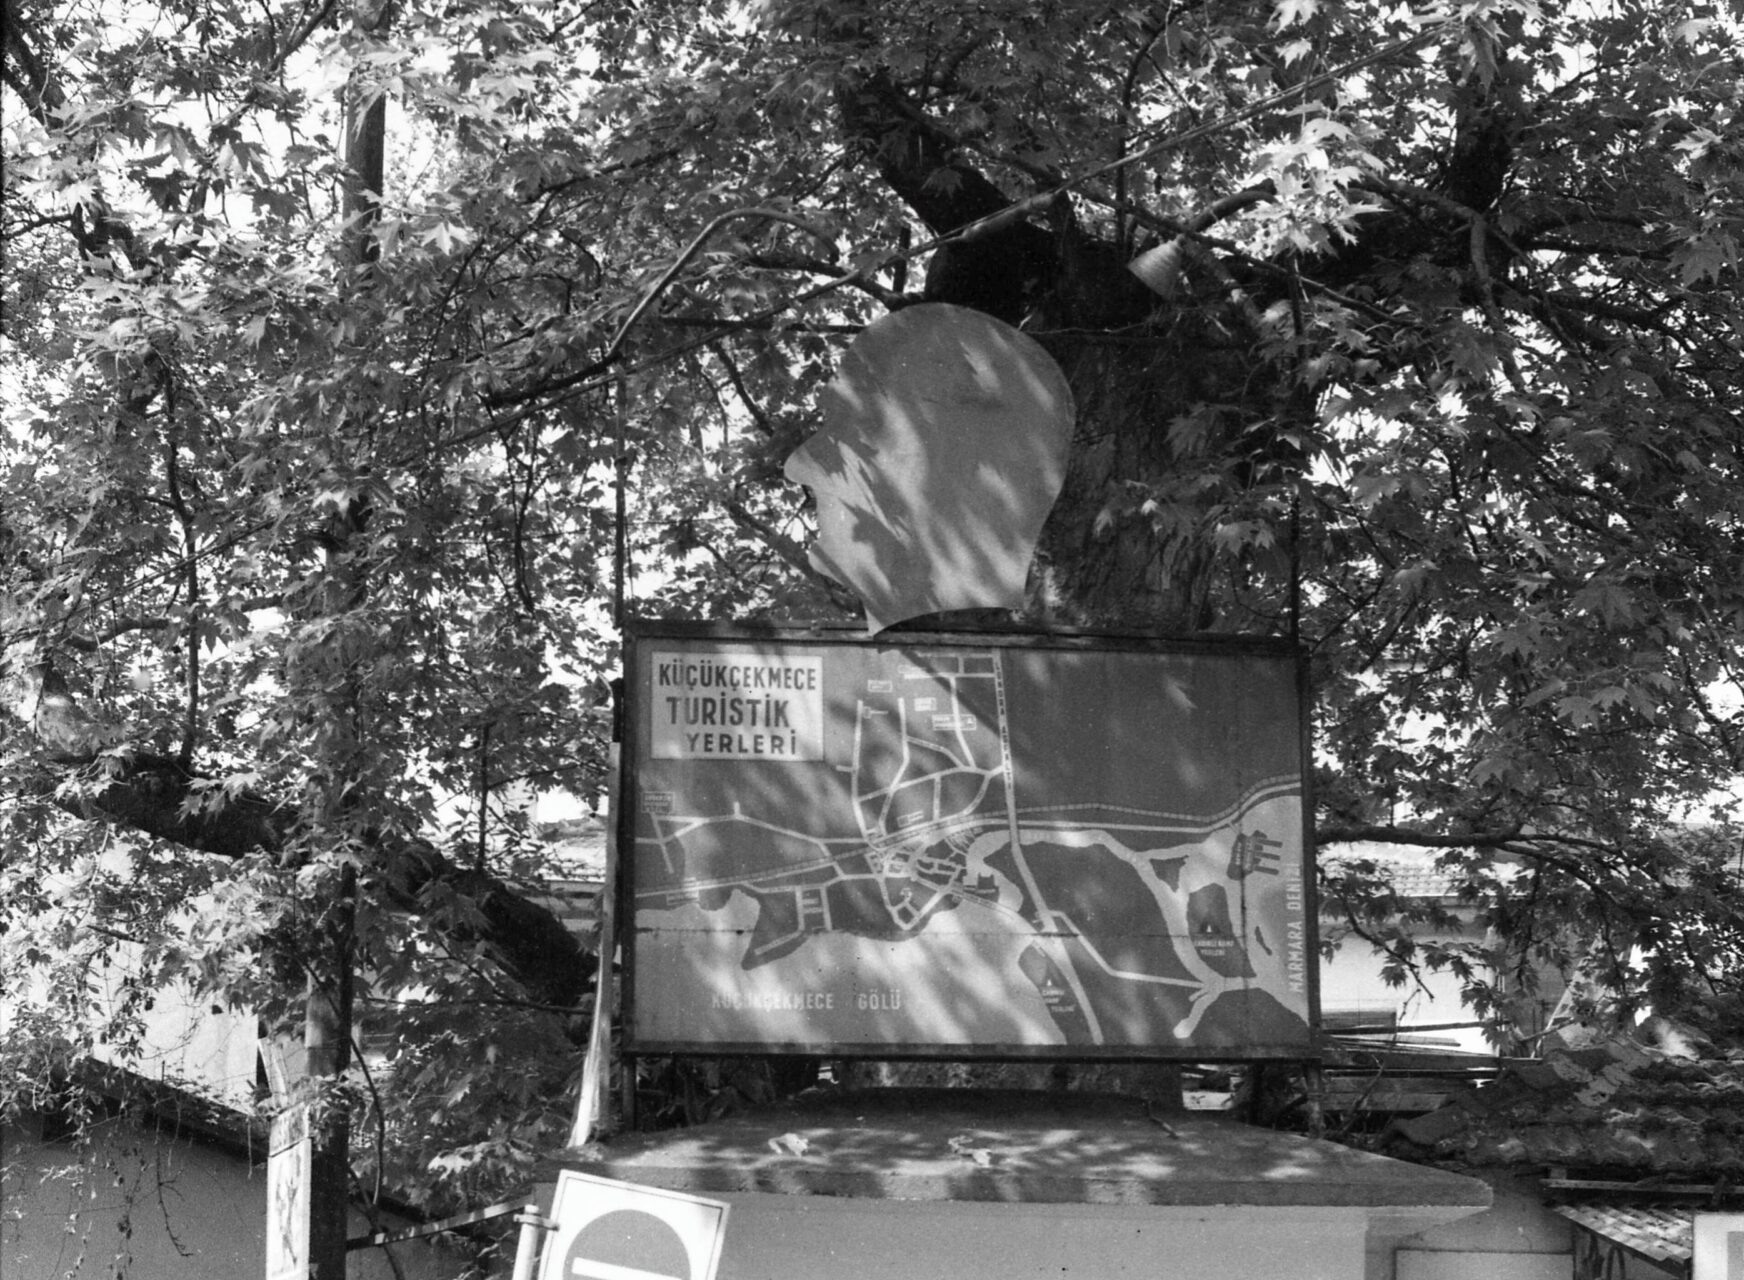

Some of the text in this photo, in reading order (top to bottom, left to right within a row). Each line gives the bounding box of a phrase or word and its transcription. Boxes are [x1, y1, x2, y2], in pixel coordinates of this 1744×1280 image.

[659, 658, 816, 691] KÜÇÜKÇEKMECE
[666, 691, 789, 727] TURİSTİK
[687, 729, 796, 755] YERLERİ
[1286, 920, 1304, 993] MARMARA
[857, 988, 901, 1010] GÖLÜ
